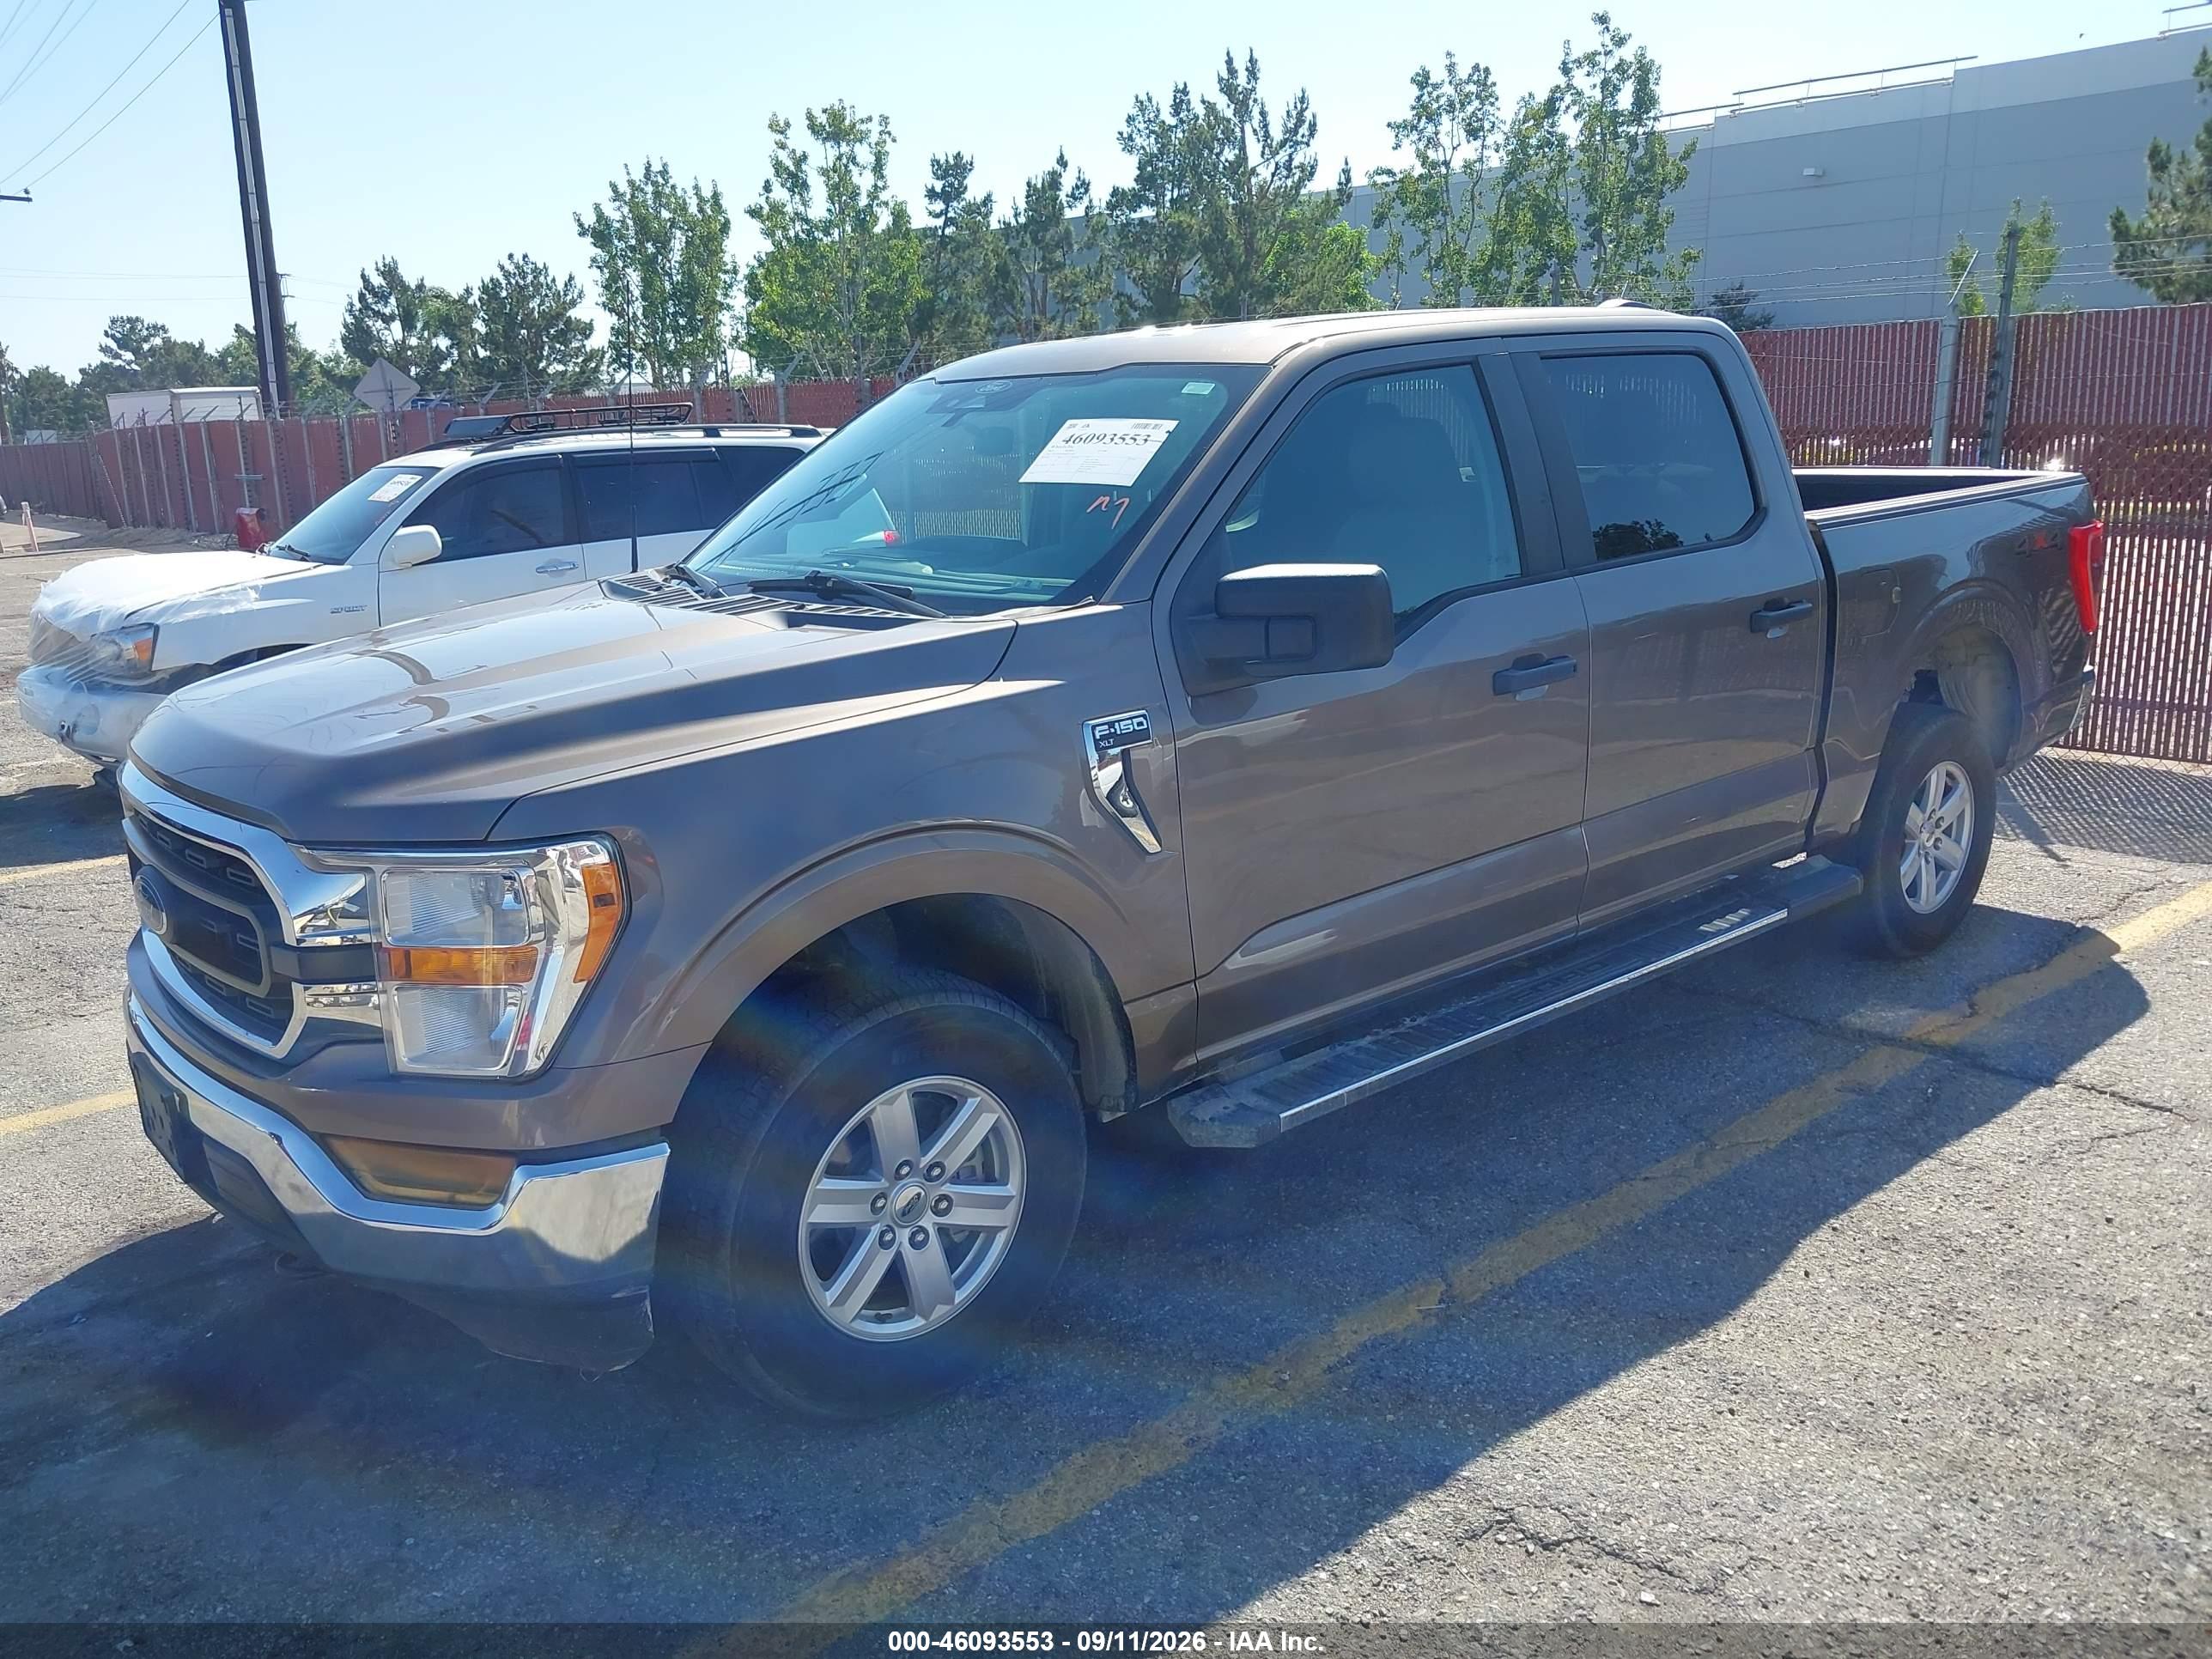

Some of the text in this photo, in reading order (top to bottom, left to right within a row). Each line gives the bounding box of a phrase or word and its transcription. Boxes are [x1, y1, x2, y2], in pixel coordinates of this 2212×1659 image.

[1061, 432, 1152, 447] 46093553
[1095, 717, 1147, 739] F-150
[1099, 738, 1114, 748] XLT
